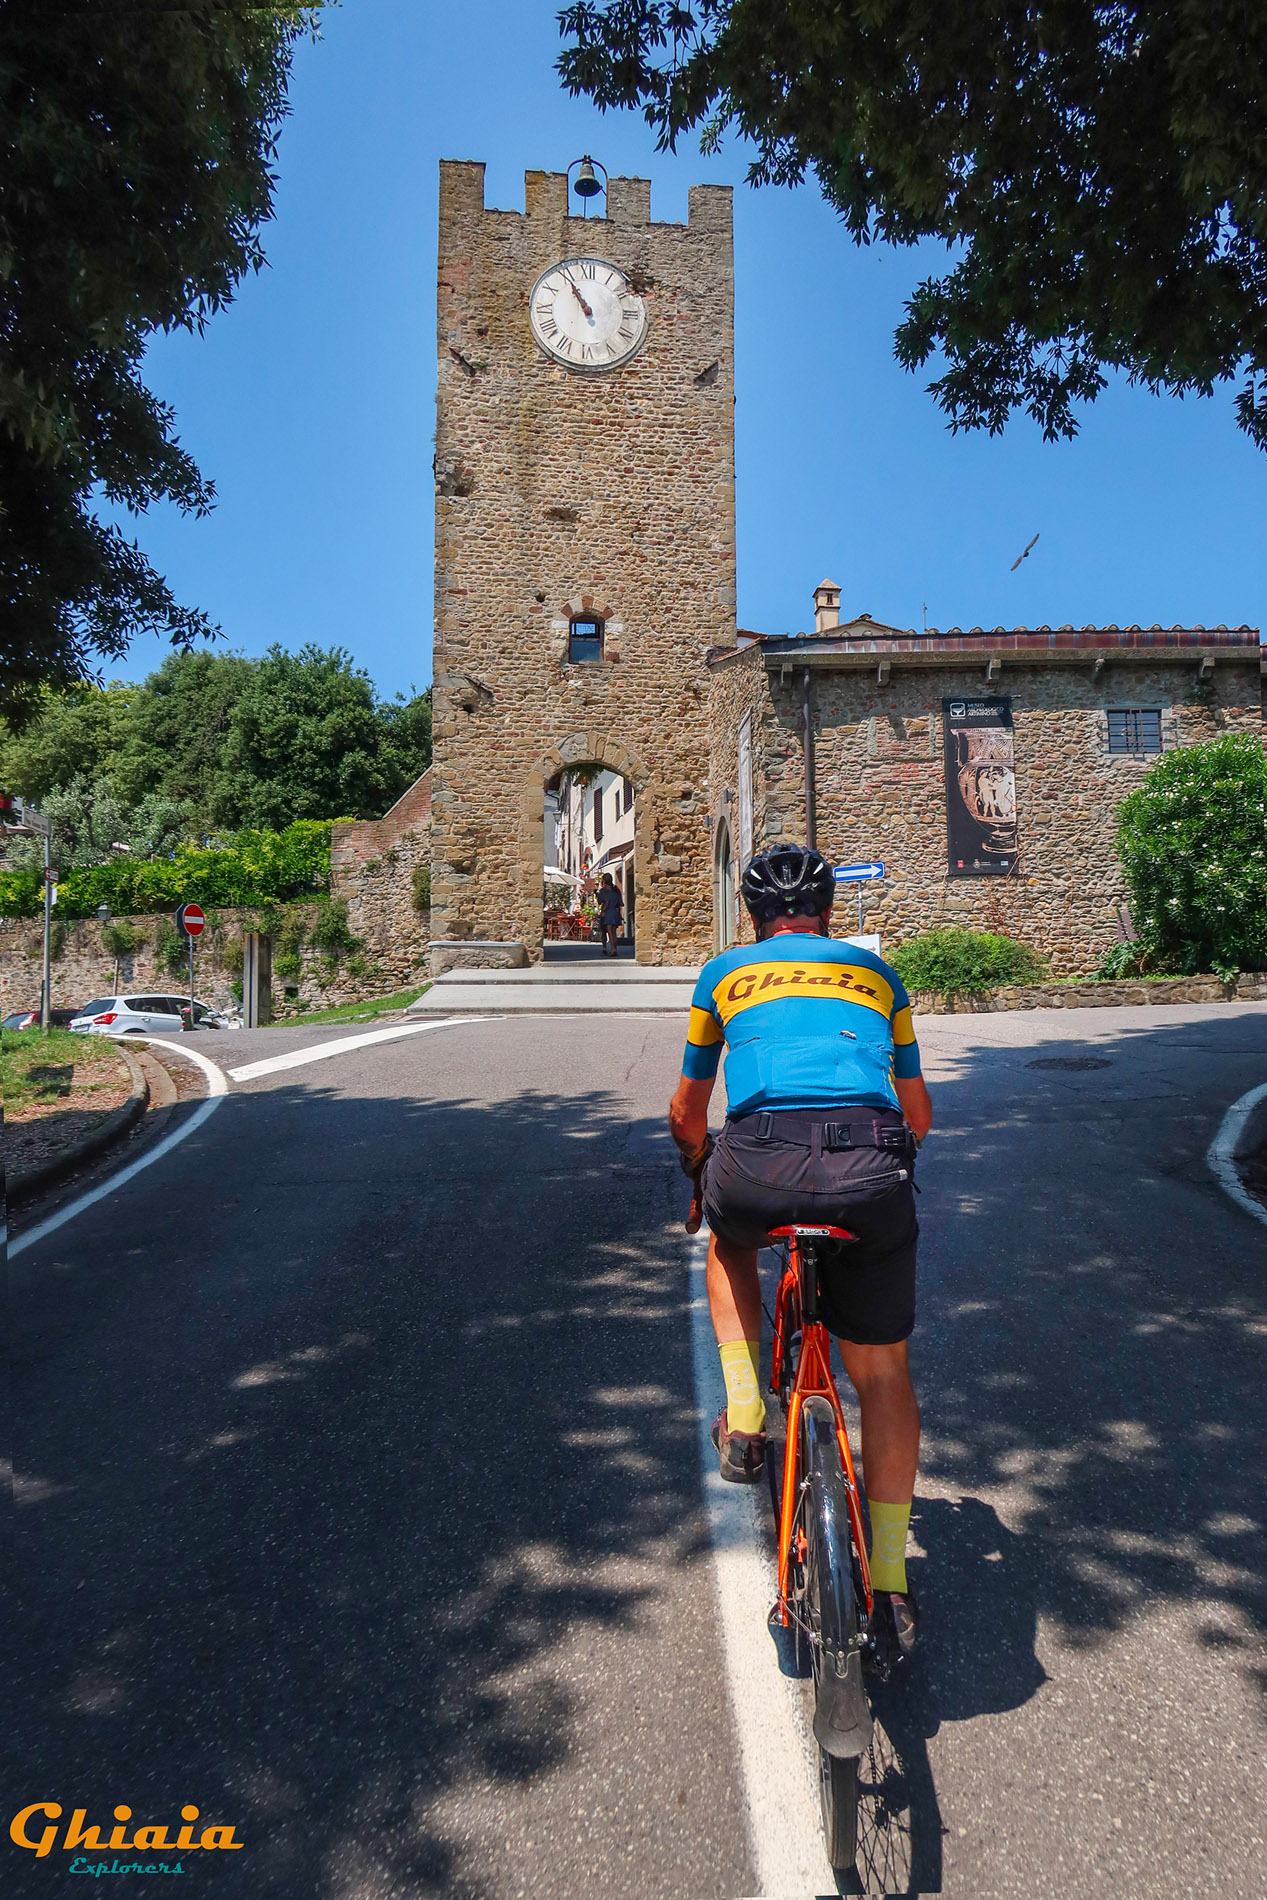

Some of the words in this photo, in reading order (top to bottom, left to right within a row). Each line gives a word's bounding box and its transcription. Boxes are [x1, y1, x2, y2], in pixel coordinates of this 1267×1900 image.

[580, 264, 596, 280] XII
[605, 272, 614, 285] I
[542, 282, 559, 296] X
[622, 309, 639, 320] III
[727, 970, 880, 1002] Ghiaia
